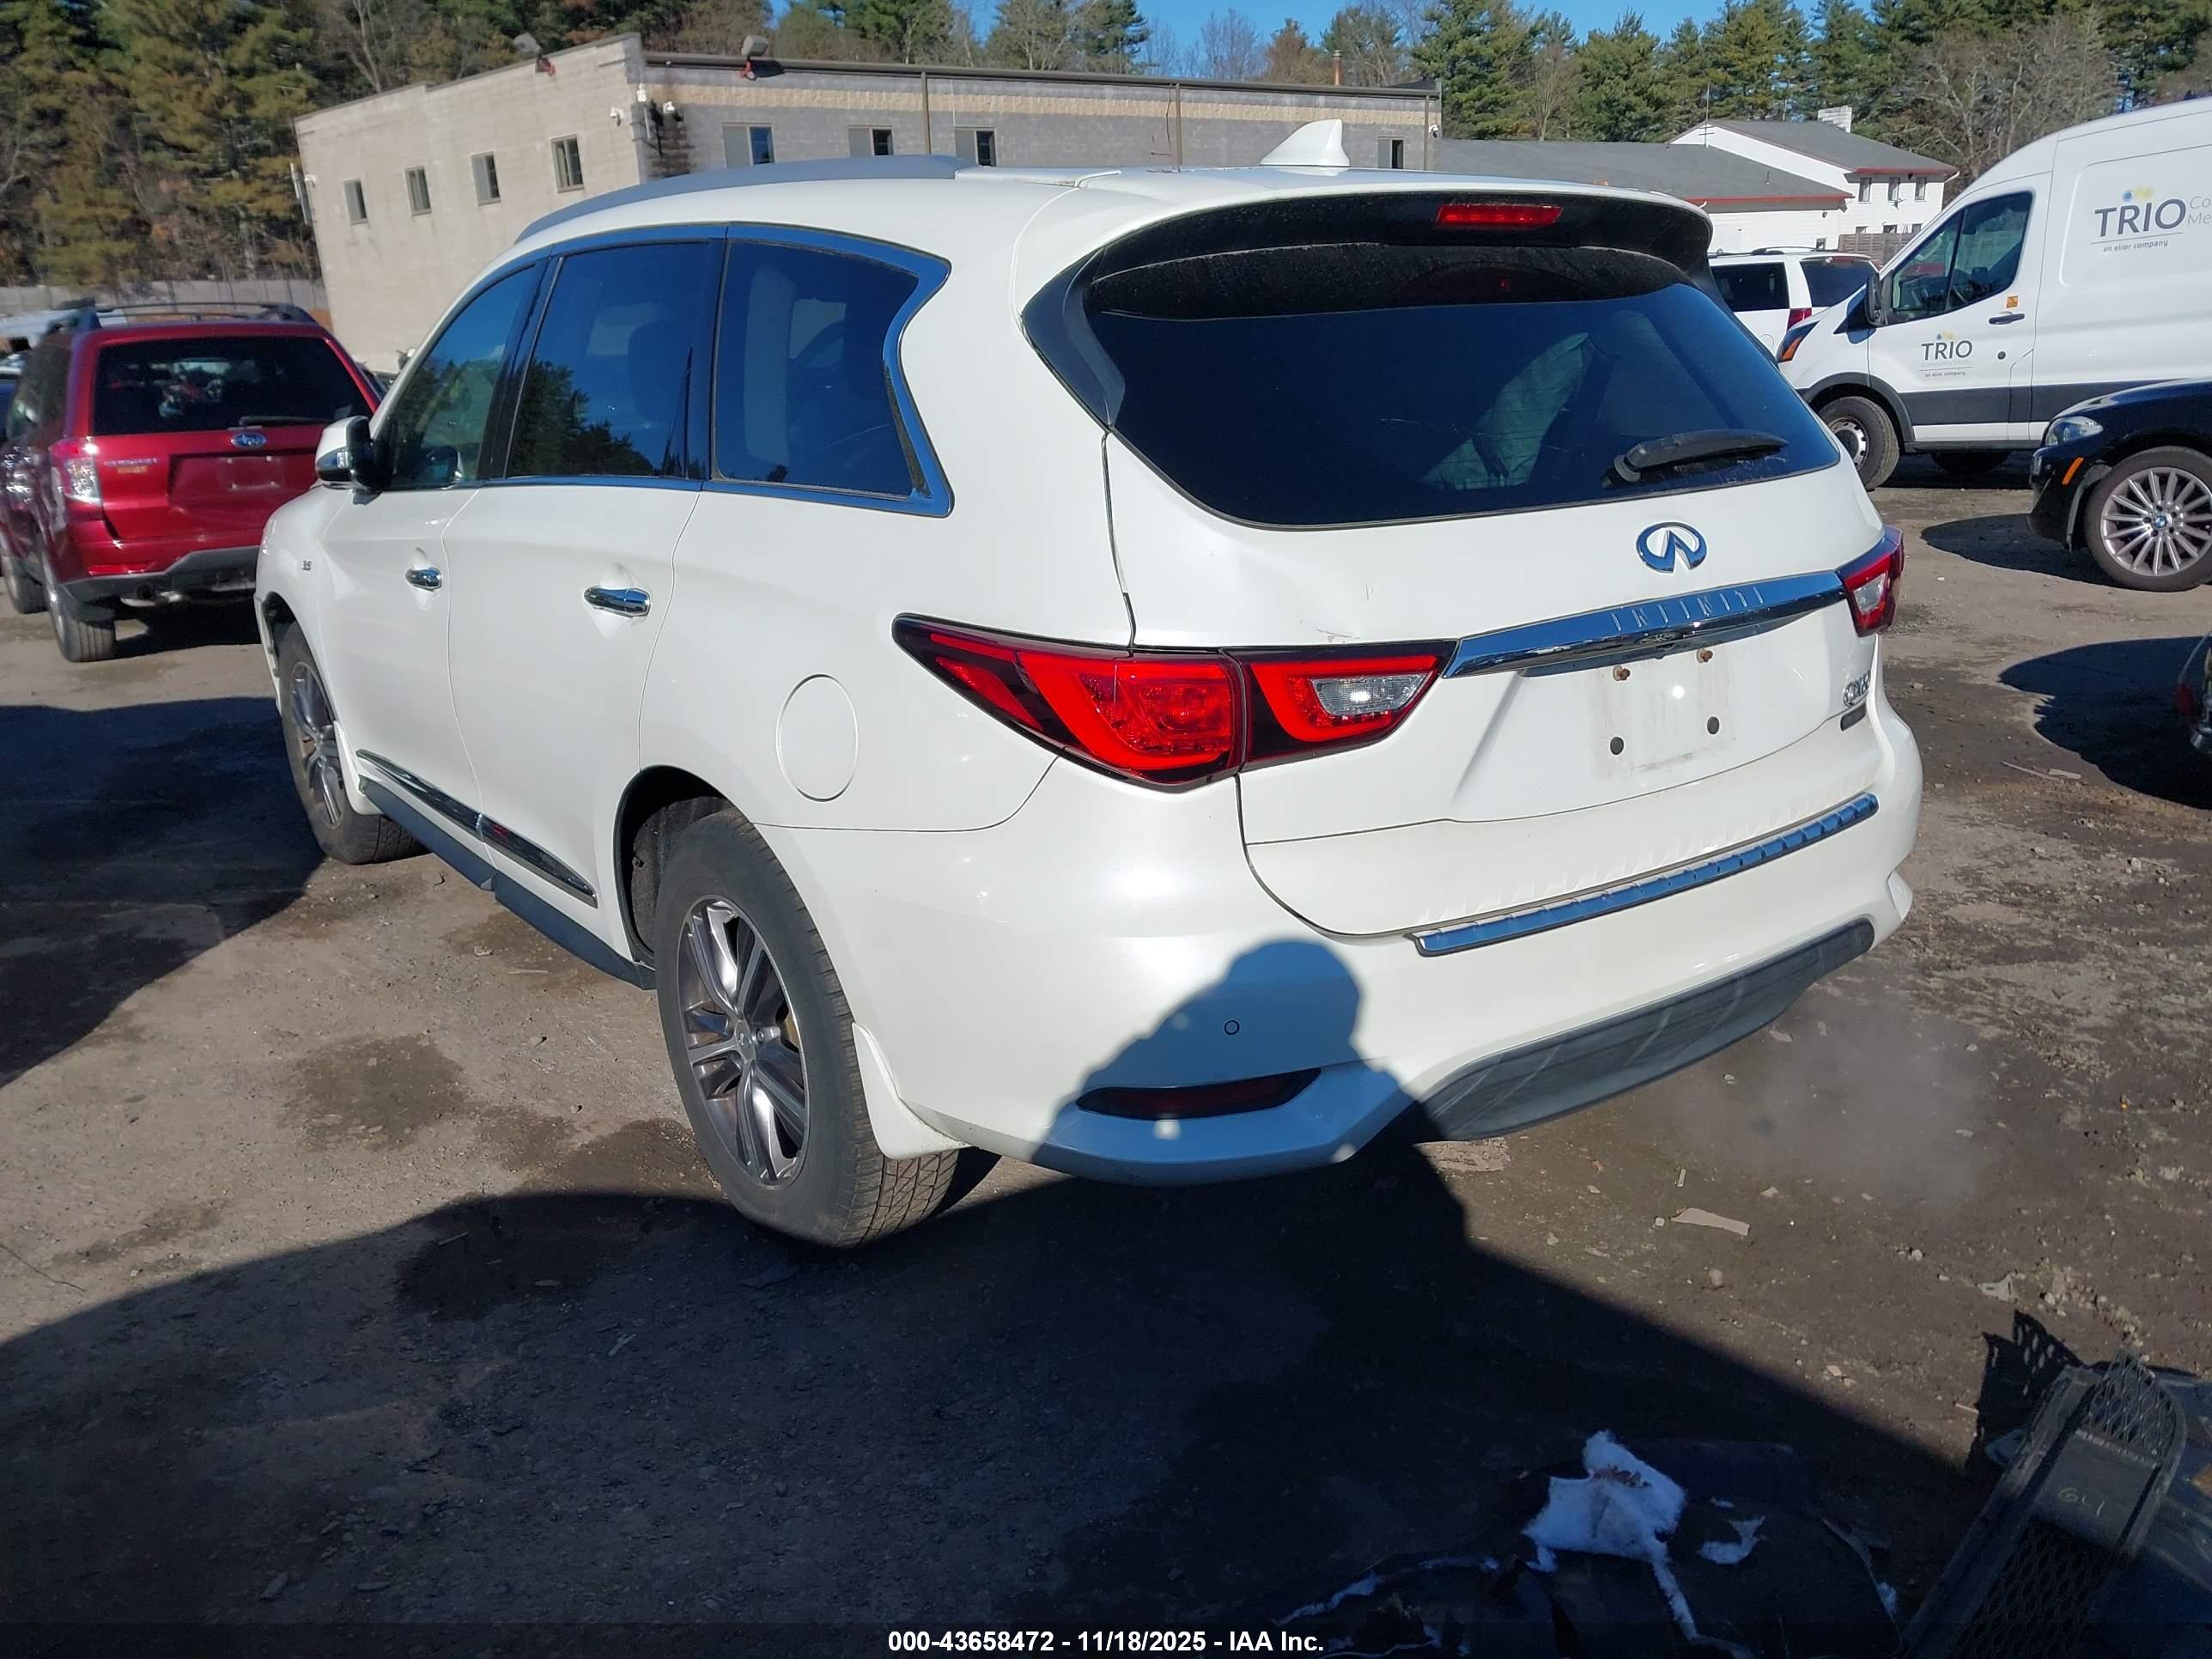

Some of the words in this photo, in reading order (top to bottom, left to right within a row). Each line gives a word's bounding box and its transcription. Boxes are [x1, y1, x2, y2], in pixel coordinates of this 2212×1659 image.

[2094, 198, 2187, 237] TRIO
[2133, 239, 2169, 250] company
[1920, 340, 1973, 361] TRIO
